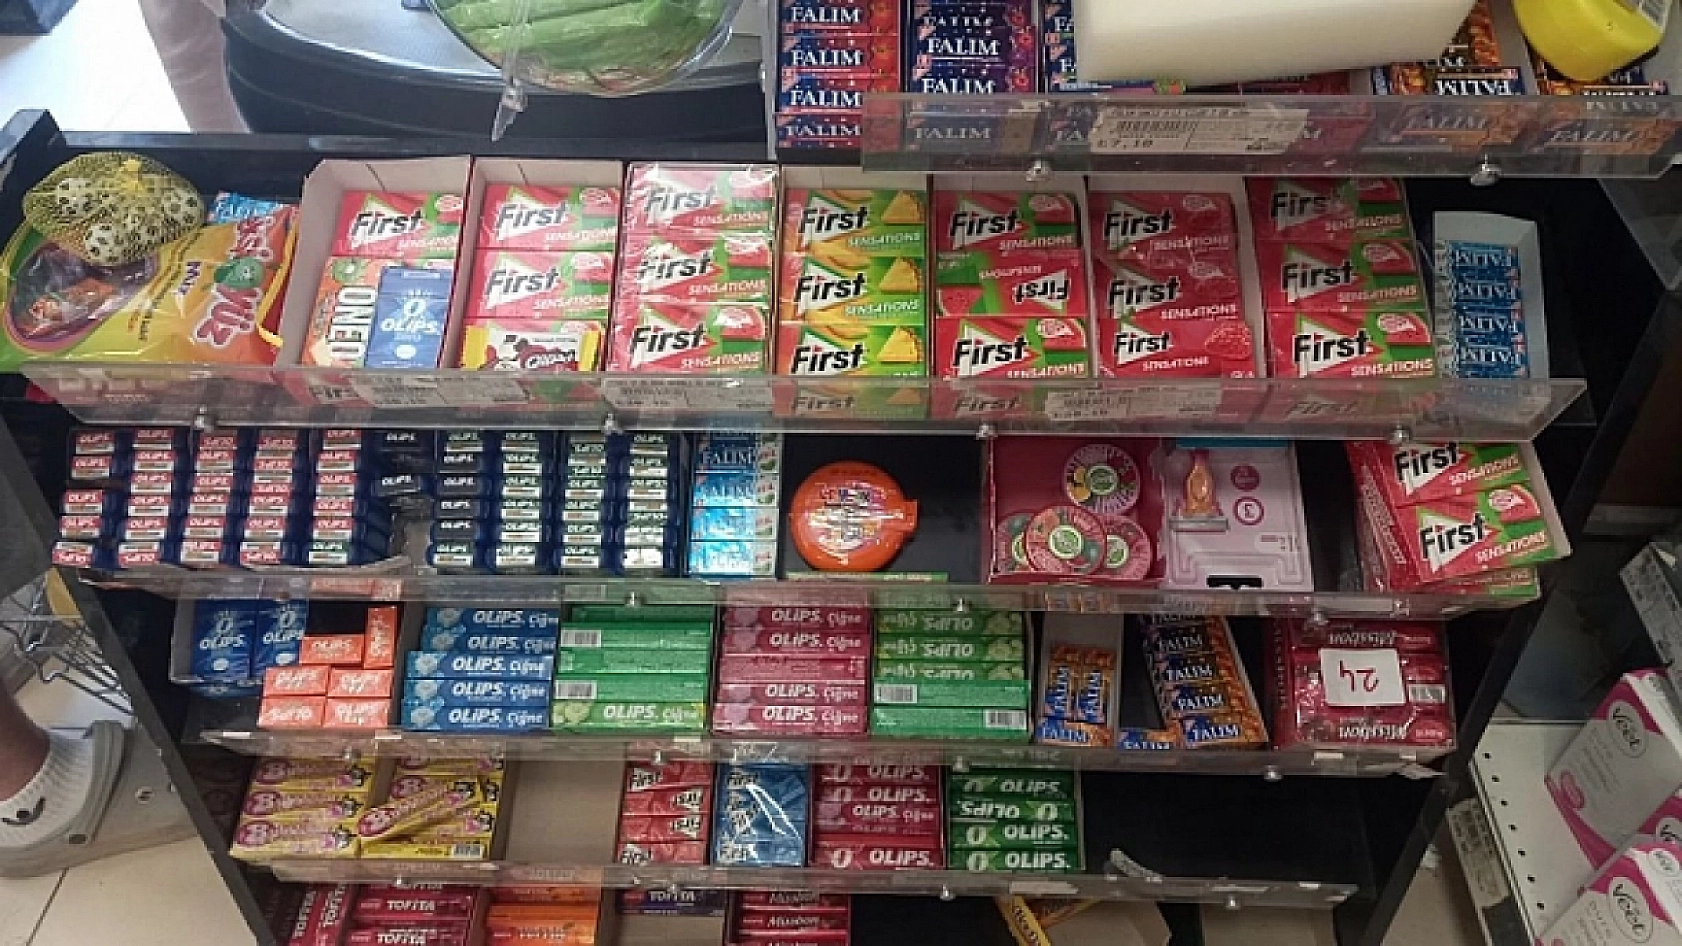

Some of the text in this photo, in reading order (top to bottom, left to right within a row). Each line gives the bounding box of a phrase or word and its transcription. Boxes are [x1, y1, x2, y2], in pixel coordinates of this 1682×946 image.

[790, 6, 859, 24] FALIM
[791, 49, 862, 67] FALIM
[927, 37, 999, 56] FALIM
[790, 90, 862, 107] FALIM
[351, 210, 423, 234] First
[497, 202, 568, 230] First
[800, 206, 868, 234] First
[950, 210, 1018, 237] First
[1104, 210, 1173, 238] First
[638, 251, 711, 278] First
[1282, 261, 1354, 289] First
[486, 267, 559, 296] First
[797, 272, 866, 303] First
[1013, 277, 1071, 302] First
[1108, 277, 1180, 304] First
[631, 323, 707, 354] First
[954, 336, 1027, 367] First
[1115, 331, 1170, 355] First
[1293, 330, 1368, 362] First
[791, 343, 863, 374] First
[1395, 443, 1458, 480] First
[1420, 513, 1486, 559] First
[1339, 660, 1379, 692] 24
[1193, 724, 1240, 742] FALIM
